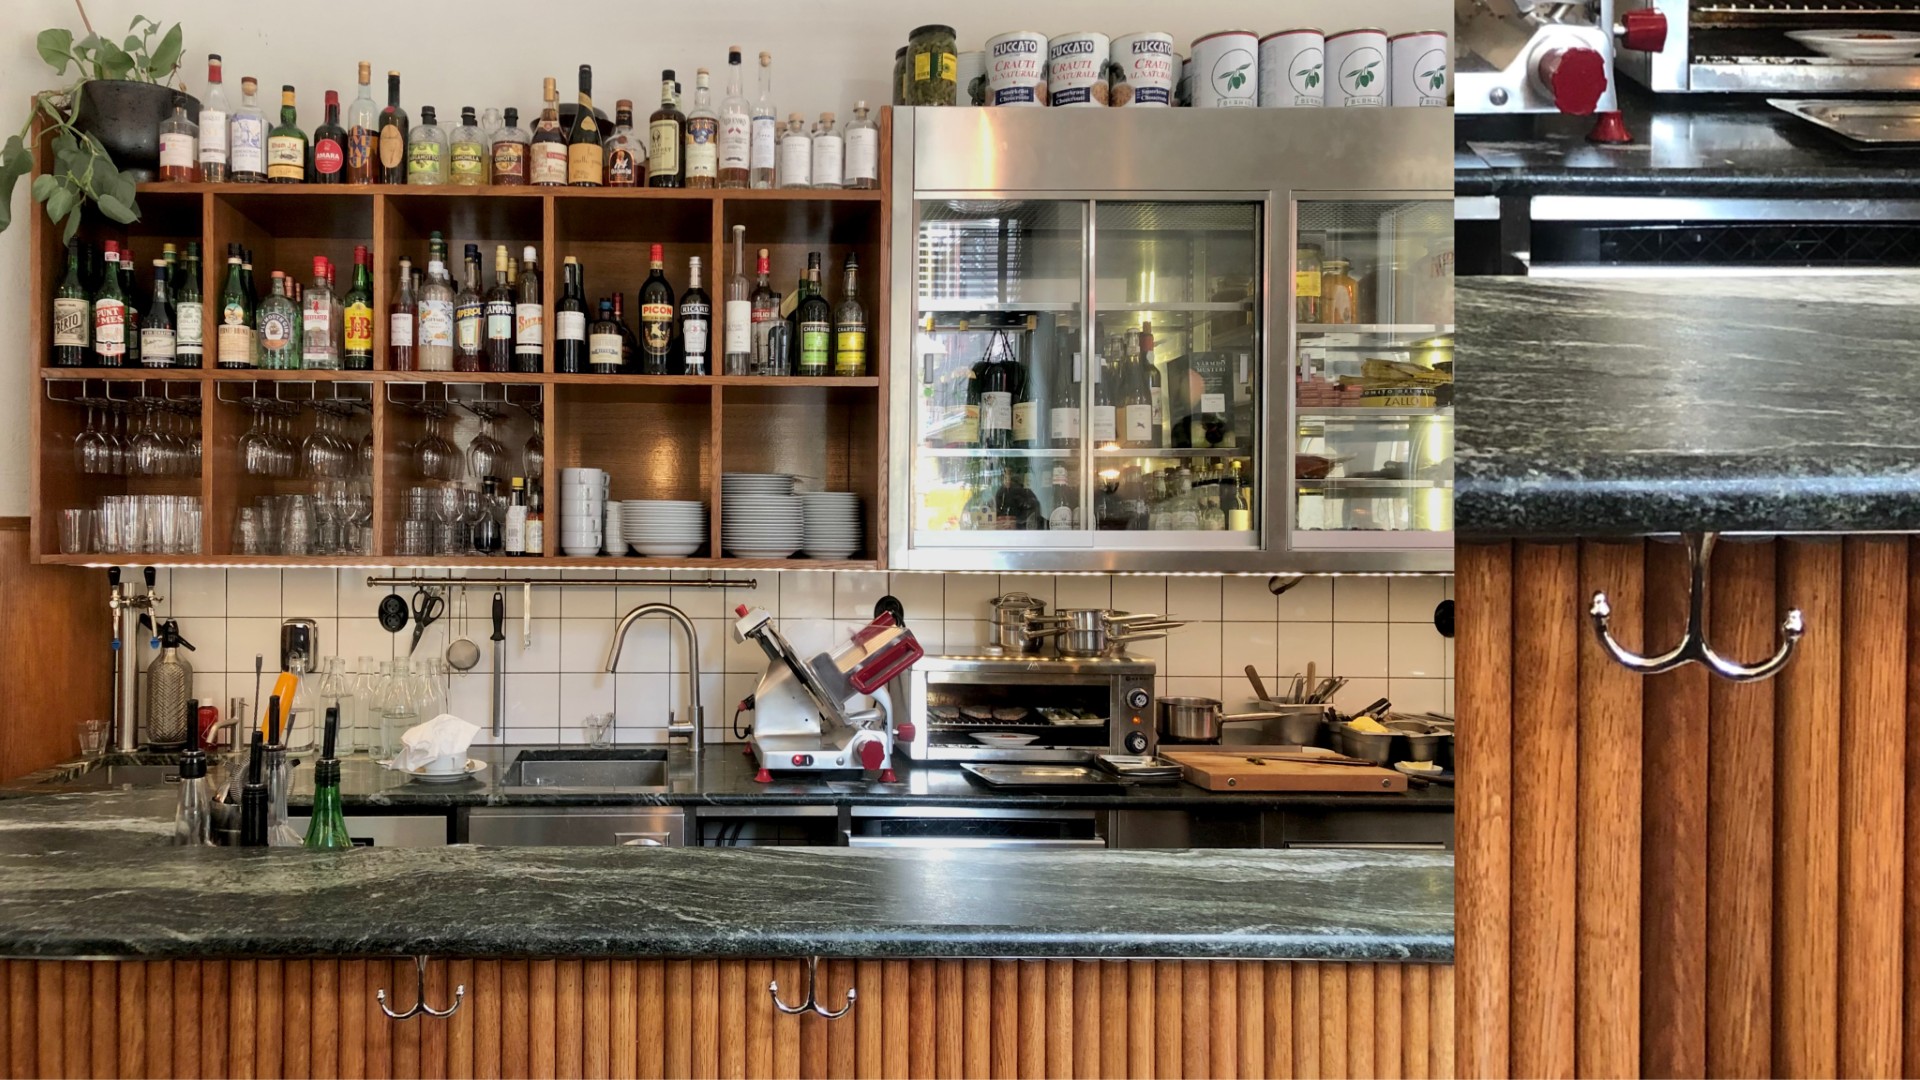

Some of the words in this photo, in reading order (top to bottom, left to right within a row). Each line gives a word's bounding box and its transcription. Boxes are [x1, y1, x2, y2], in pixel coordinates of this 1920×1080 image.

[994, 41, 1037, 56] ZUCCATO
[1051, 41, 1093, 58] ZUCCATO
[1133, 41, 1171, 55] ZUCCATO
[994, 60, 1035, 72] CRAUTI
[1052, 61, 1092, 75] CRAUTI
[1135, 59, 1171, 71] CRAUTI
[97, 307, 119, 317] PUNT
[457, 307, 482, 319] APEROL
[486, 305, 514, 315] CAMPARI
[643, 306, 672, 316] PICON
[682, 306, 709, 314] RICARD
[56, 314, 79, 335] BERTO
[101, 315, 125, 325] MES
[261, 314, 284, 333] PLYMOUTH
[282, 321, 290, 333] GIN
[346, 316, 371, 340] J&B
[1384, 398, 1420, 406] ZALLO
